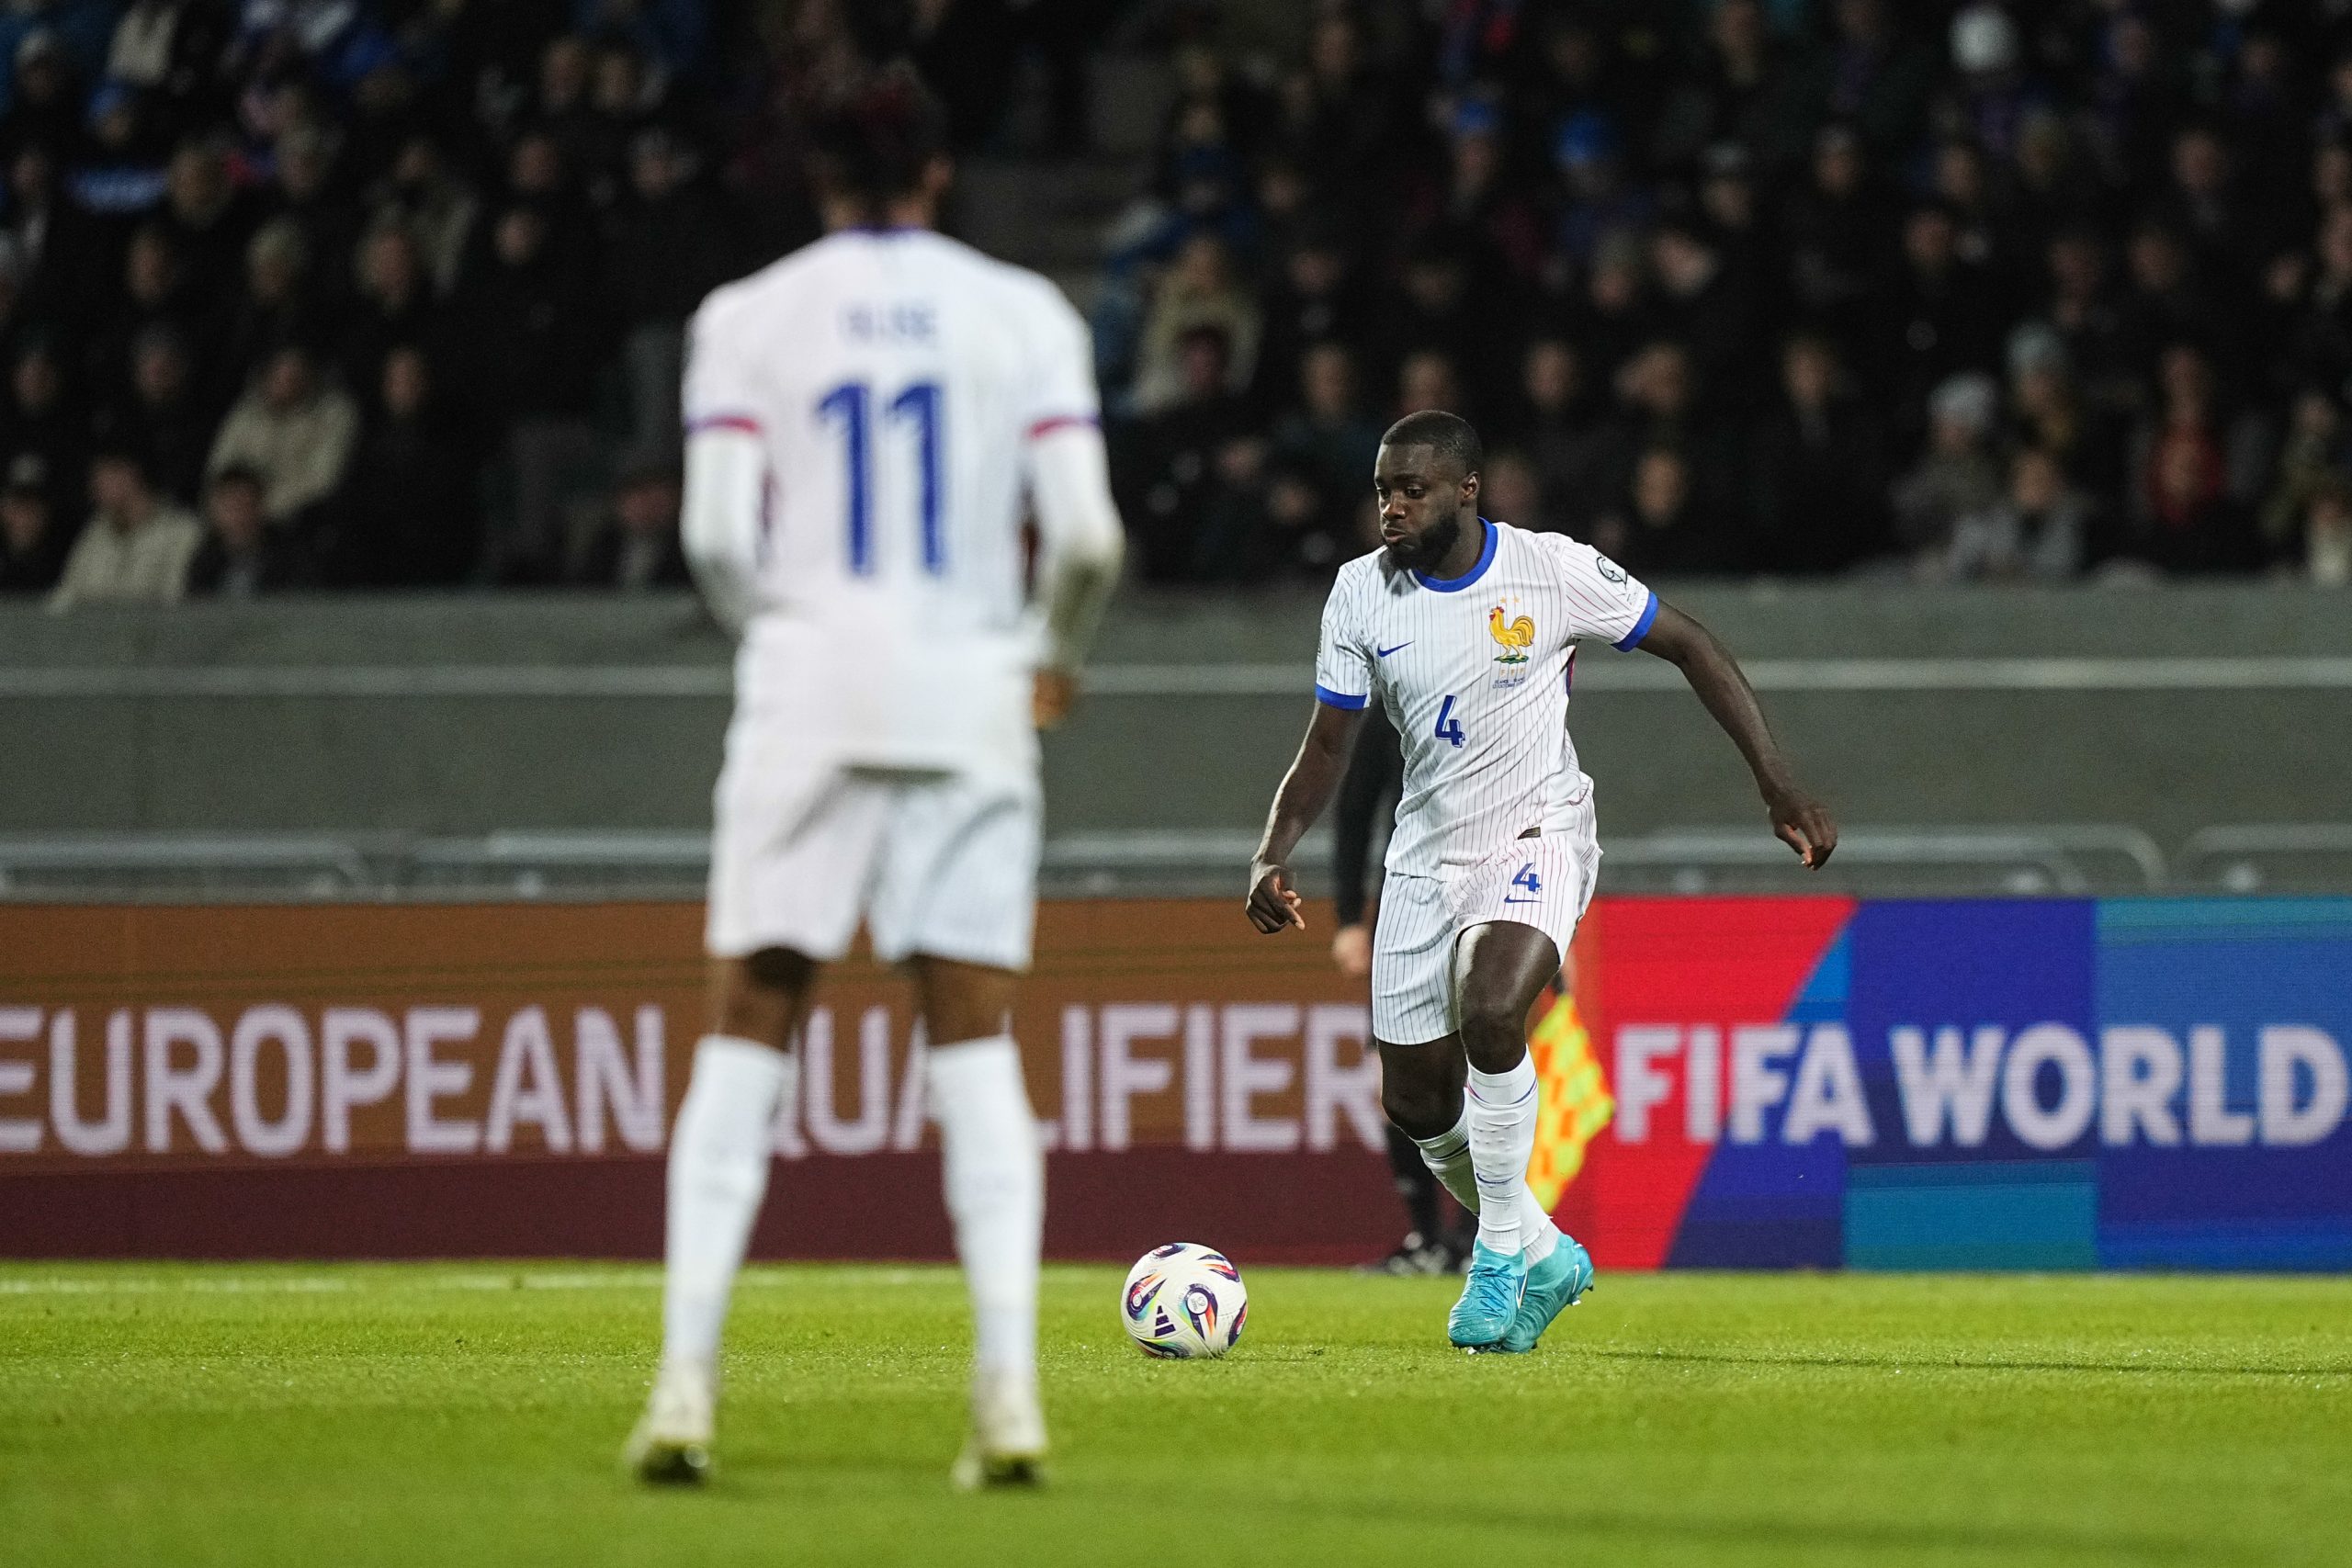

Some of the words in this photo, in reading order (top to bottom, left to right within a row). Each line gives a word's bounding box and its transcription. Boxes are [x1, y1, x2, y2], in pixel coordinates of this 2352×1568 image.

[813, 380, 944, 577] 11
[1434, 694, 1465, 748] 4
[1511, 862, 1543, 895] 4
[0, 1005, 665, 1155] EUROPEAN
[768, 1005, 1388, 1158] UIFIER
[1614, 1023, 1874, 1146] FIFA
[1888, 1022, 2349, 1149] WORLD
